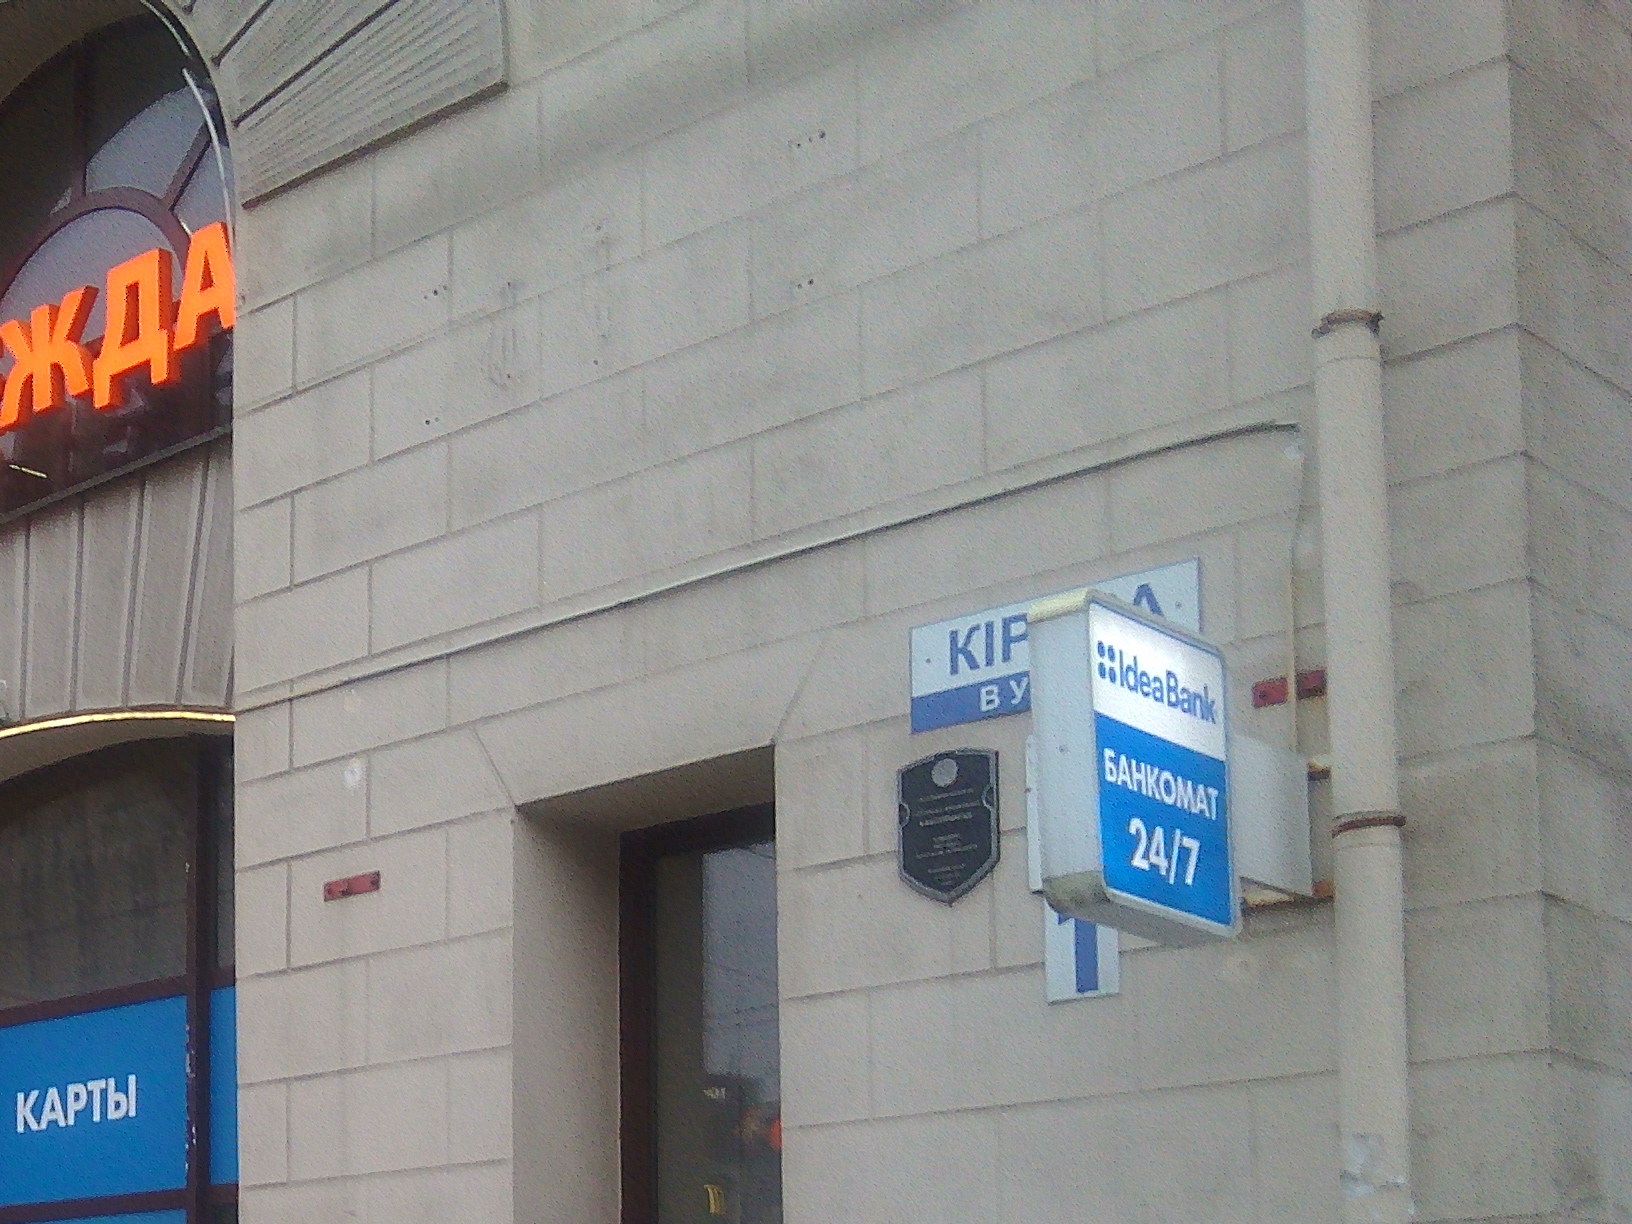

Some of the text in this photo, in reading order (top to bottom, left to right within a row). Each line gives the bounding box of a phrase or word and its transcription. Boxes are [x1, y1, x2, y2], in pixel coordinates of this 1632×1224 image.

[1119, 648, 1217, 724] IdeaBank
[1103, 748, 1220, 822] БАНКОМАТ
[1127, 817, 1201, 888] 24/7
[15, 1074, 137, 1134] КАРТЫ
